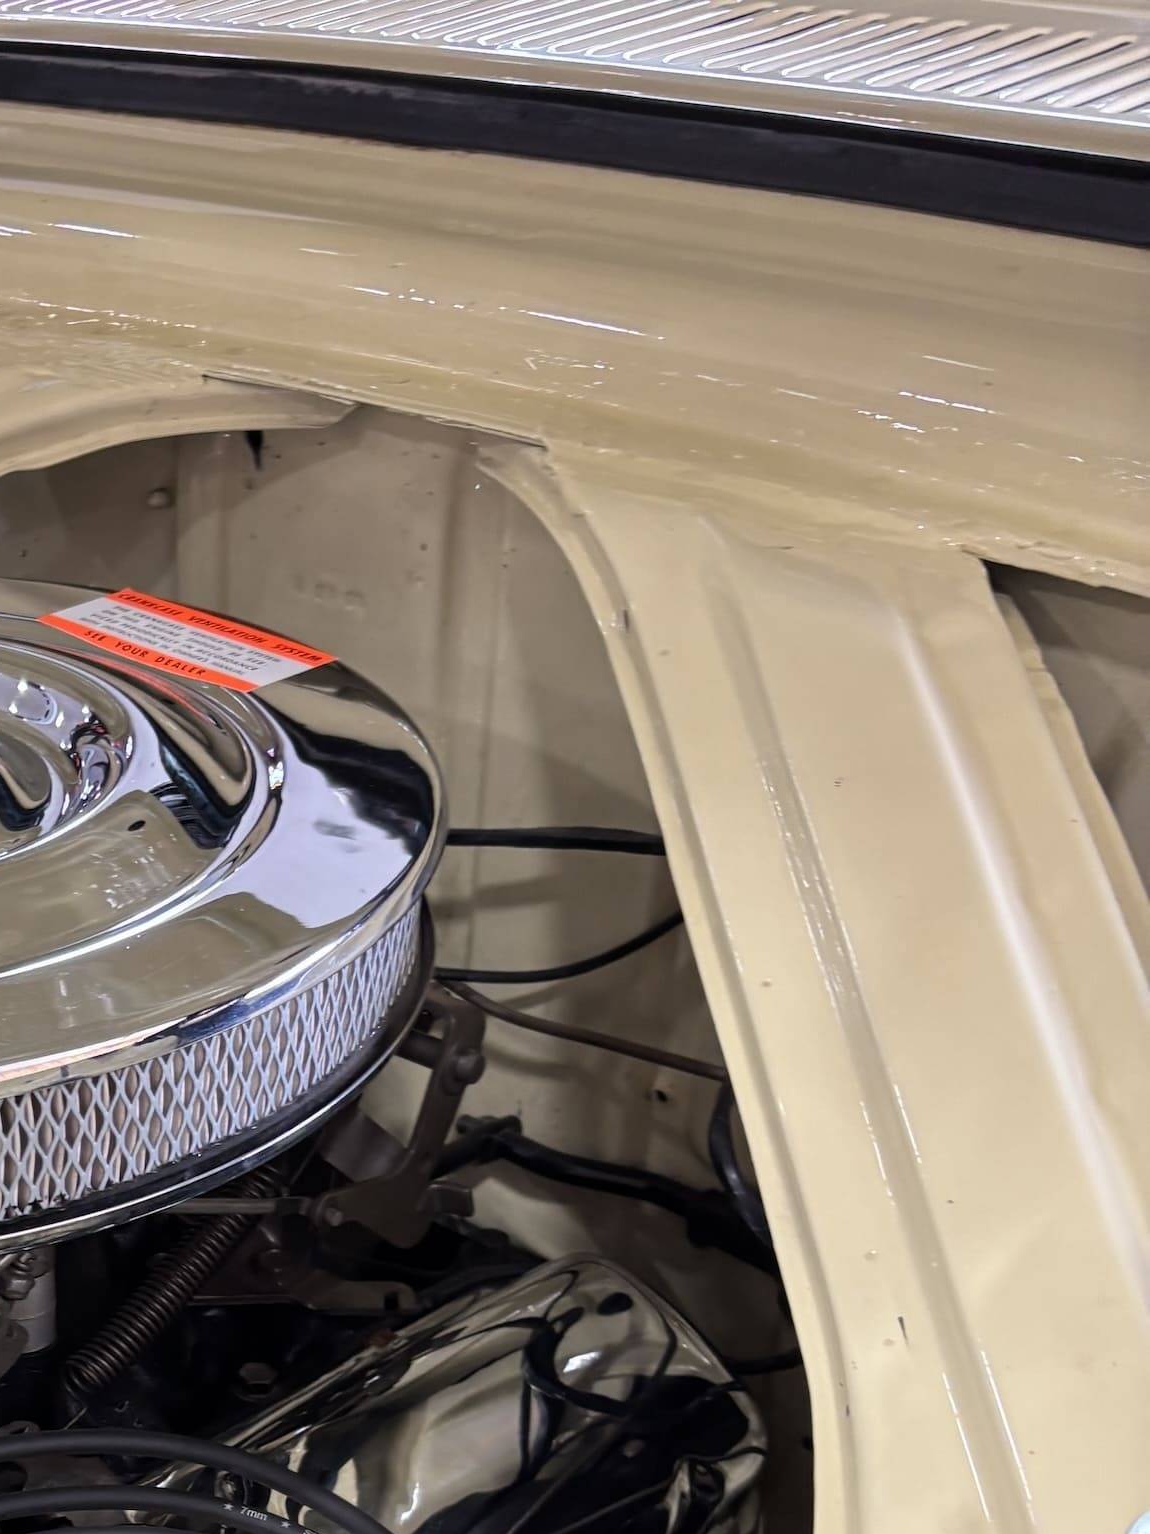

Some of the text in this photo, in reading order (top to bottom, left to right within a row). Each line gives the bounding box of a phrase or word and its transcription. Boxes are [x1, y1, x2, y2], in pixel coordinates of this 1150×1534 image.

[83, 630, 207, 677] SEE YOUR DEALER
[187, 615, 267, 644] VENTILATION
[271, 643, 323, 662] SYSTEM
[240, 1505, 268, 1522] 7mm
